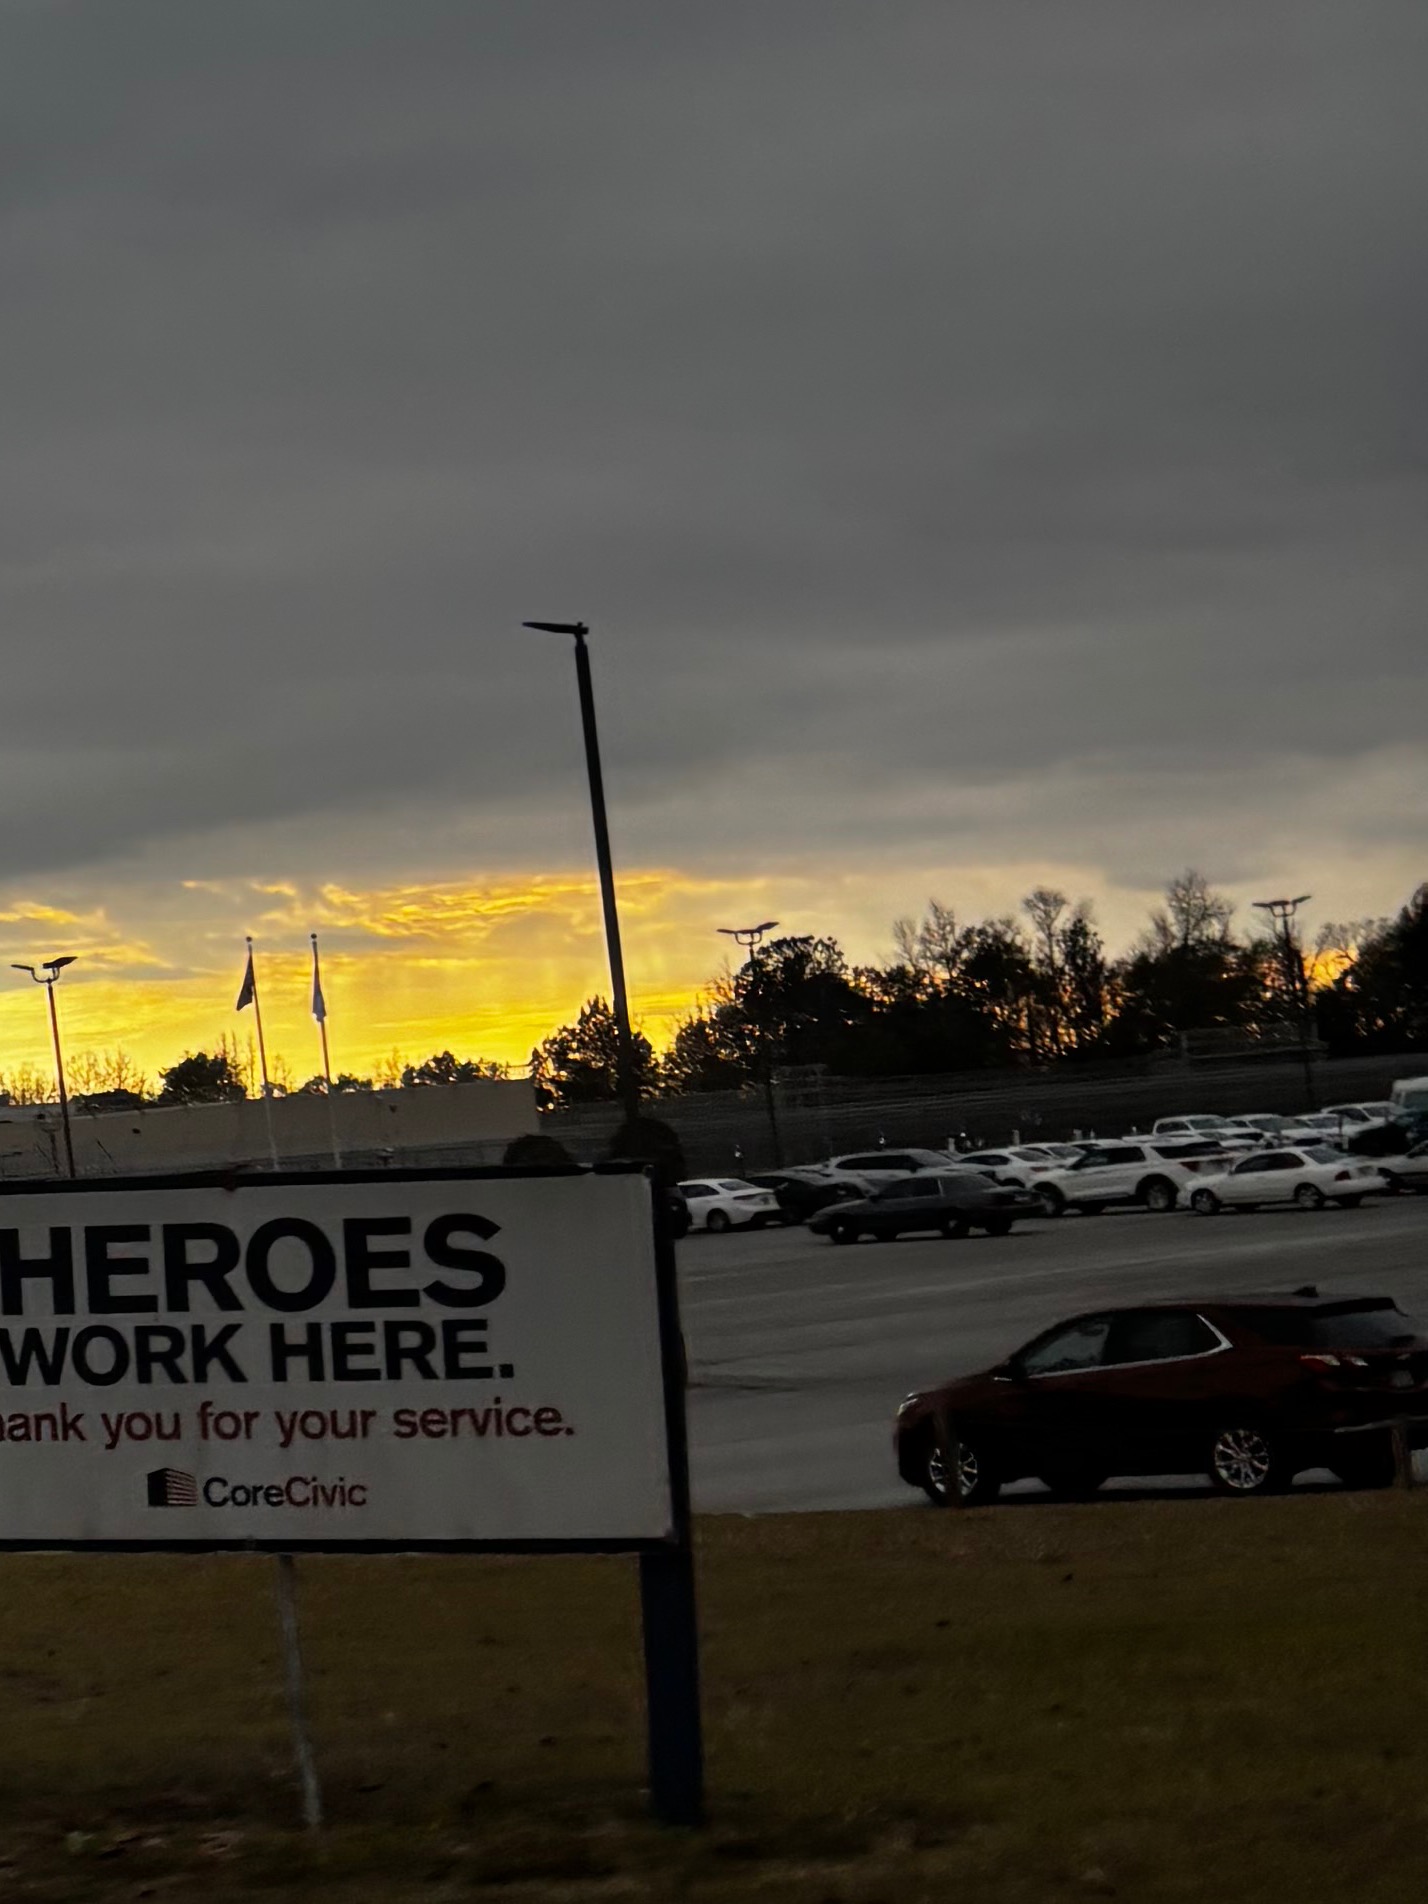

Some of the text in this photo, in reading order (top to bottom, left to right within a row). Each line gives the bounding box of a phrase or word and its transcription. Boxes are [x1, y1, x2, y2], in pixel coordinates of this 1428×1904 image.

[270, 1319, 514, 1382] HERE.
[101, 1409, 181, 1450] you
[197, 1401, 260, 1440] for
[275, 1410, 376, 1448] your
[393, 1397, 574, 1438] service.
[203, 1476, 367, 1507] CoreCivic
